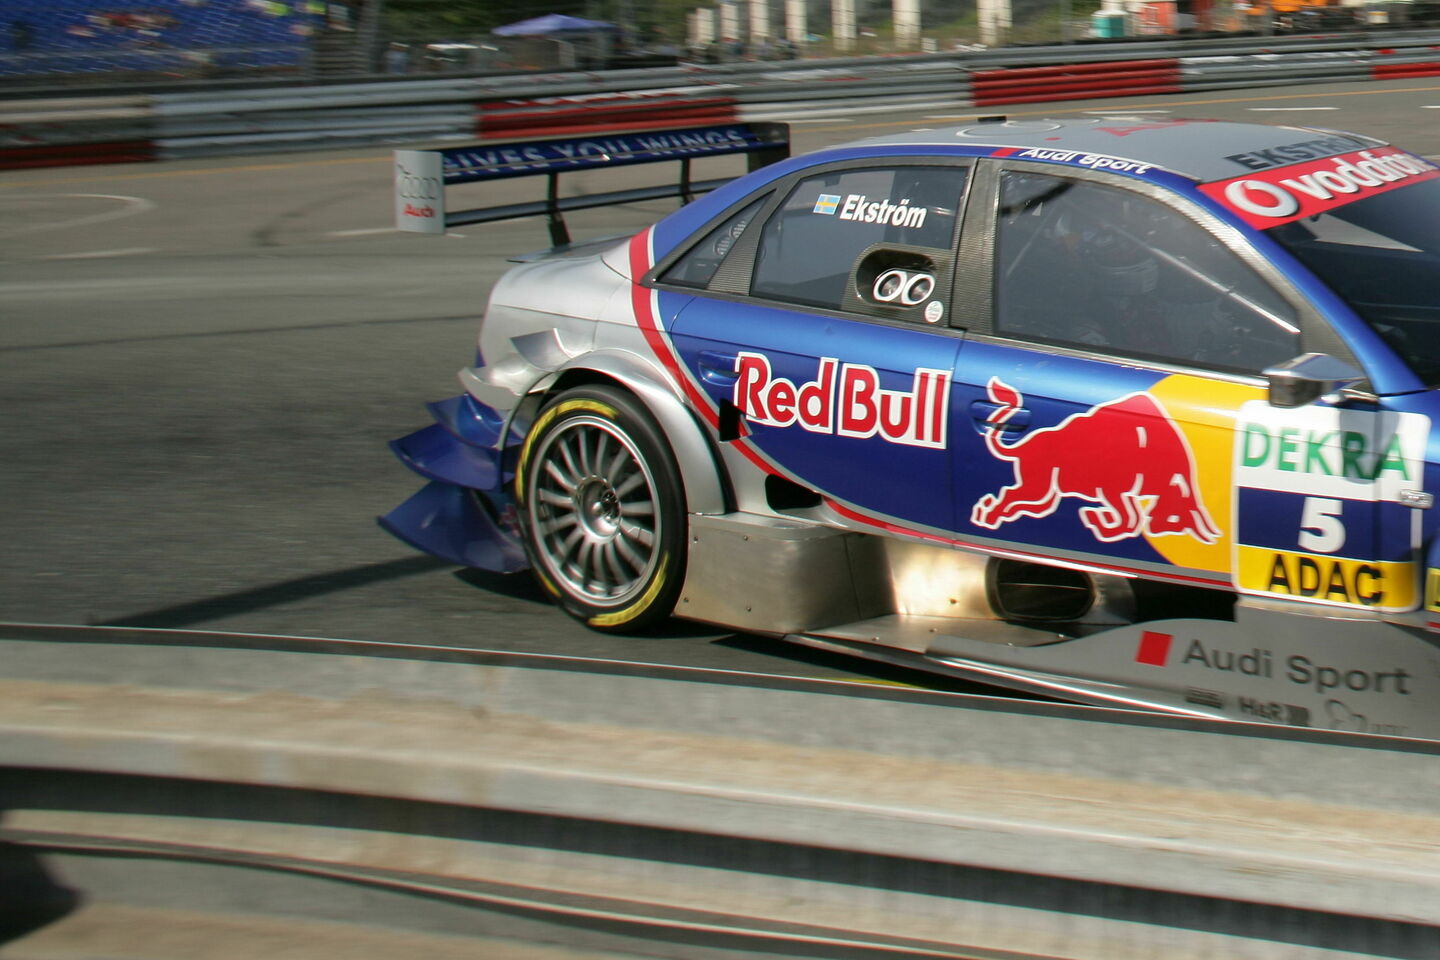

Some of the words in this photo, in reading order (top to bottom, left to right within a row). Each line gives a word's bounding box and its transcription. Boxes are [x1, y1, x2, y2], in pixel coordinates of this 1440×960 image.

[551, 140, 635, 164] YOU
[635, 130, 749, 156] WINGS
[1009, 146, 1079, 162] Audi
[839, 194, 928, 229] Ekström
[1240, 422, 1414, 483] DEKRA
[1297, 496, 1347, 554] 5
[1267, 553, 1387, 607] ADAC
[1182, 638, 1273, 679] Audi
[1286, 653, 1414, 696] Sport
